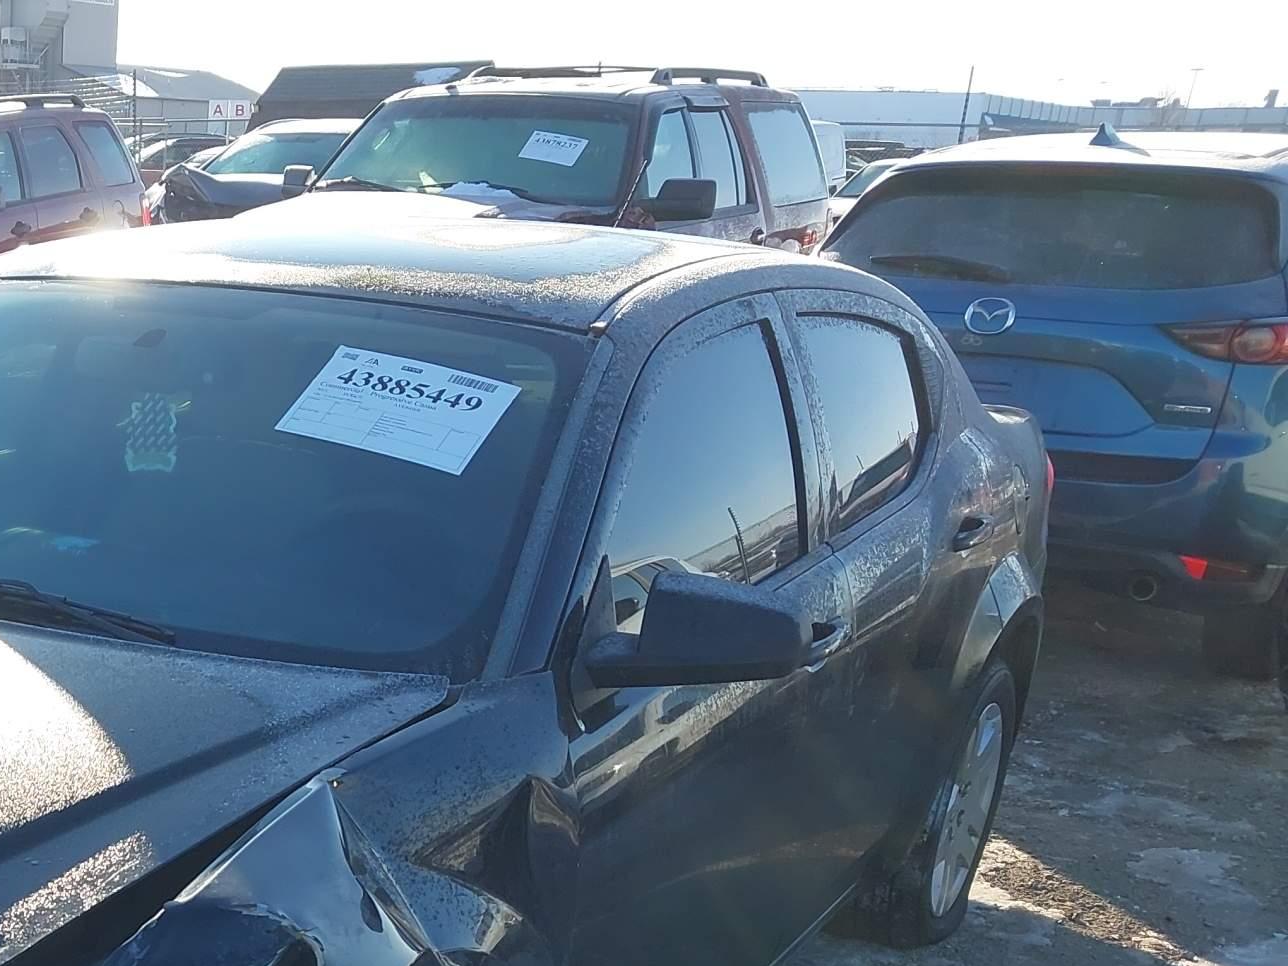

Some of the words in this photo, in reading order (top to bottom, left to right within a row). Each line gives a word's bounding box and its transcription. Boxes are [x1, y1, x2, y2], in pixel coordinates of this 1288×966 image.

[213, 104, 223, 116] A
[235, 104, 245, 116] B
[336, 367, 484, 412] 43885449
